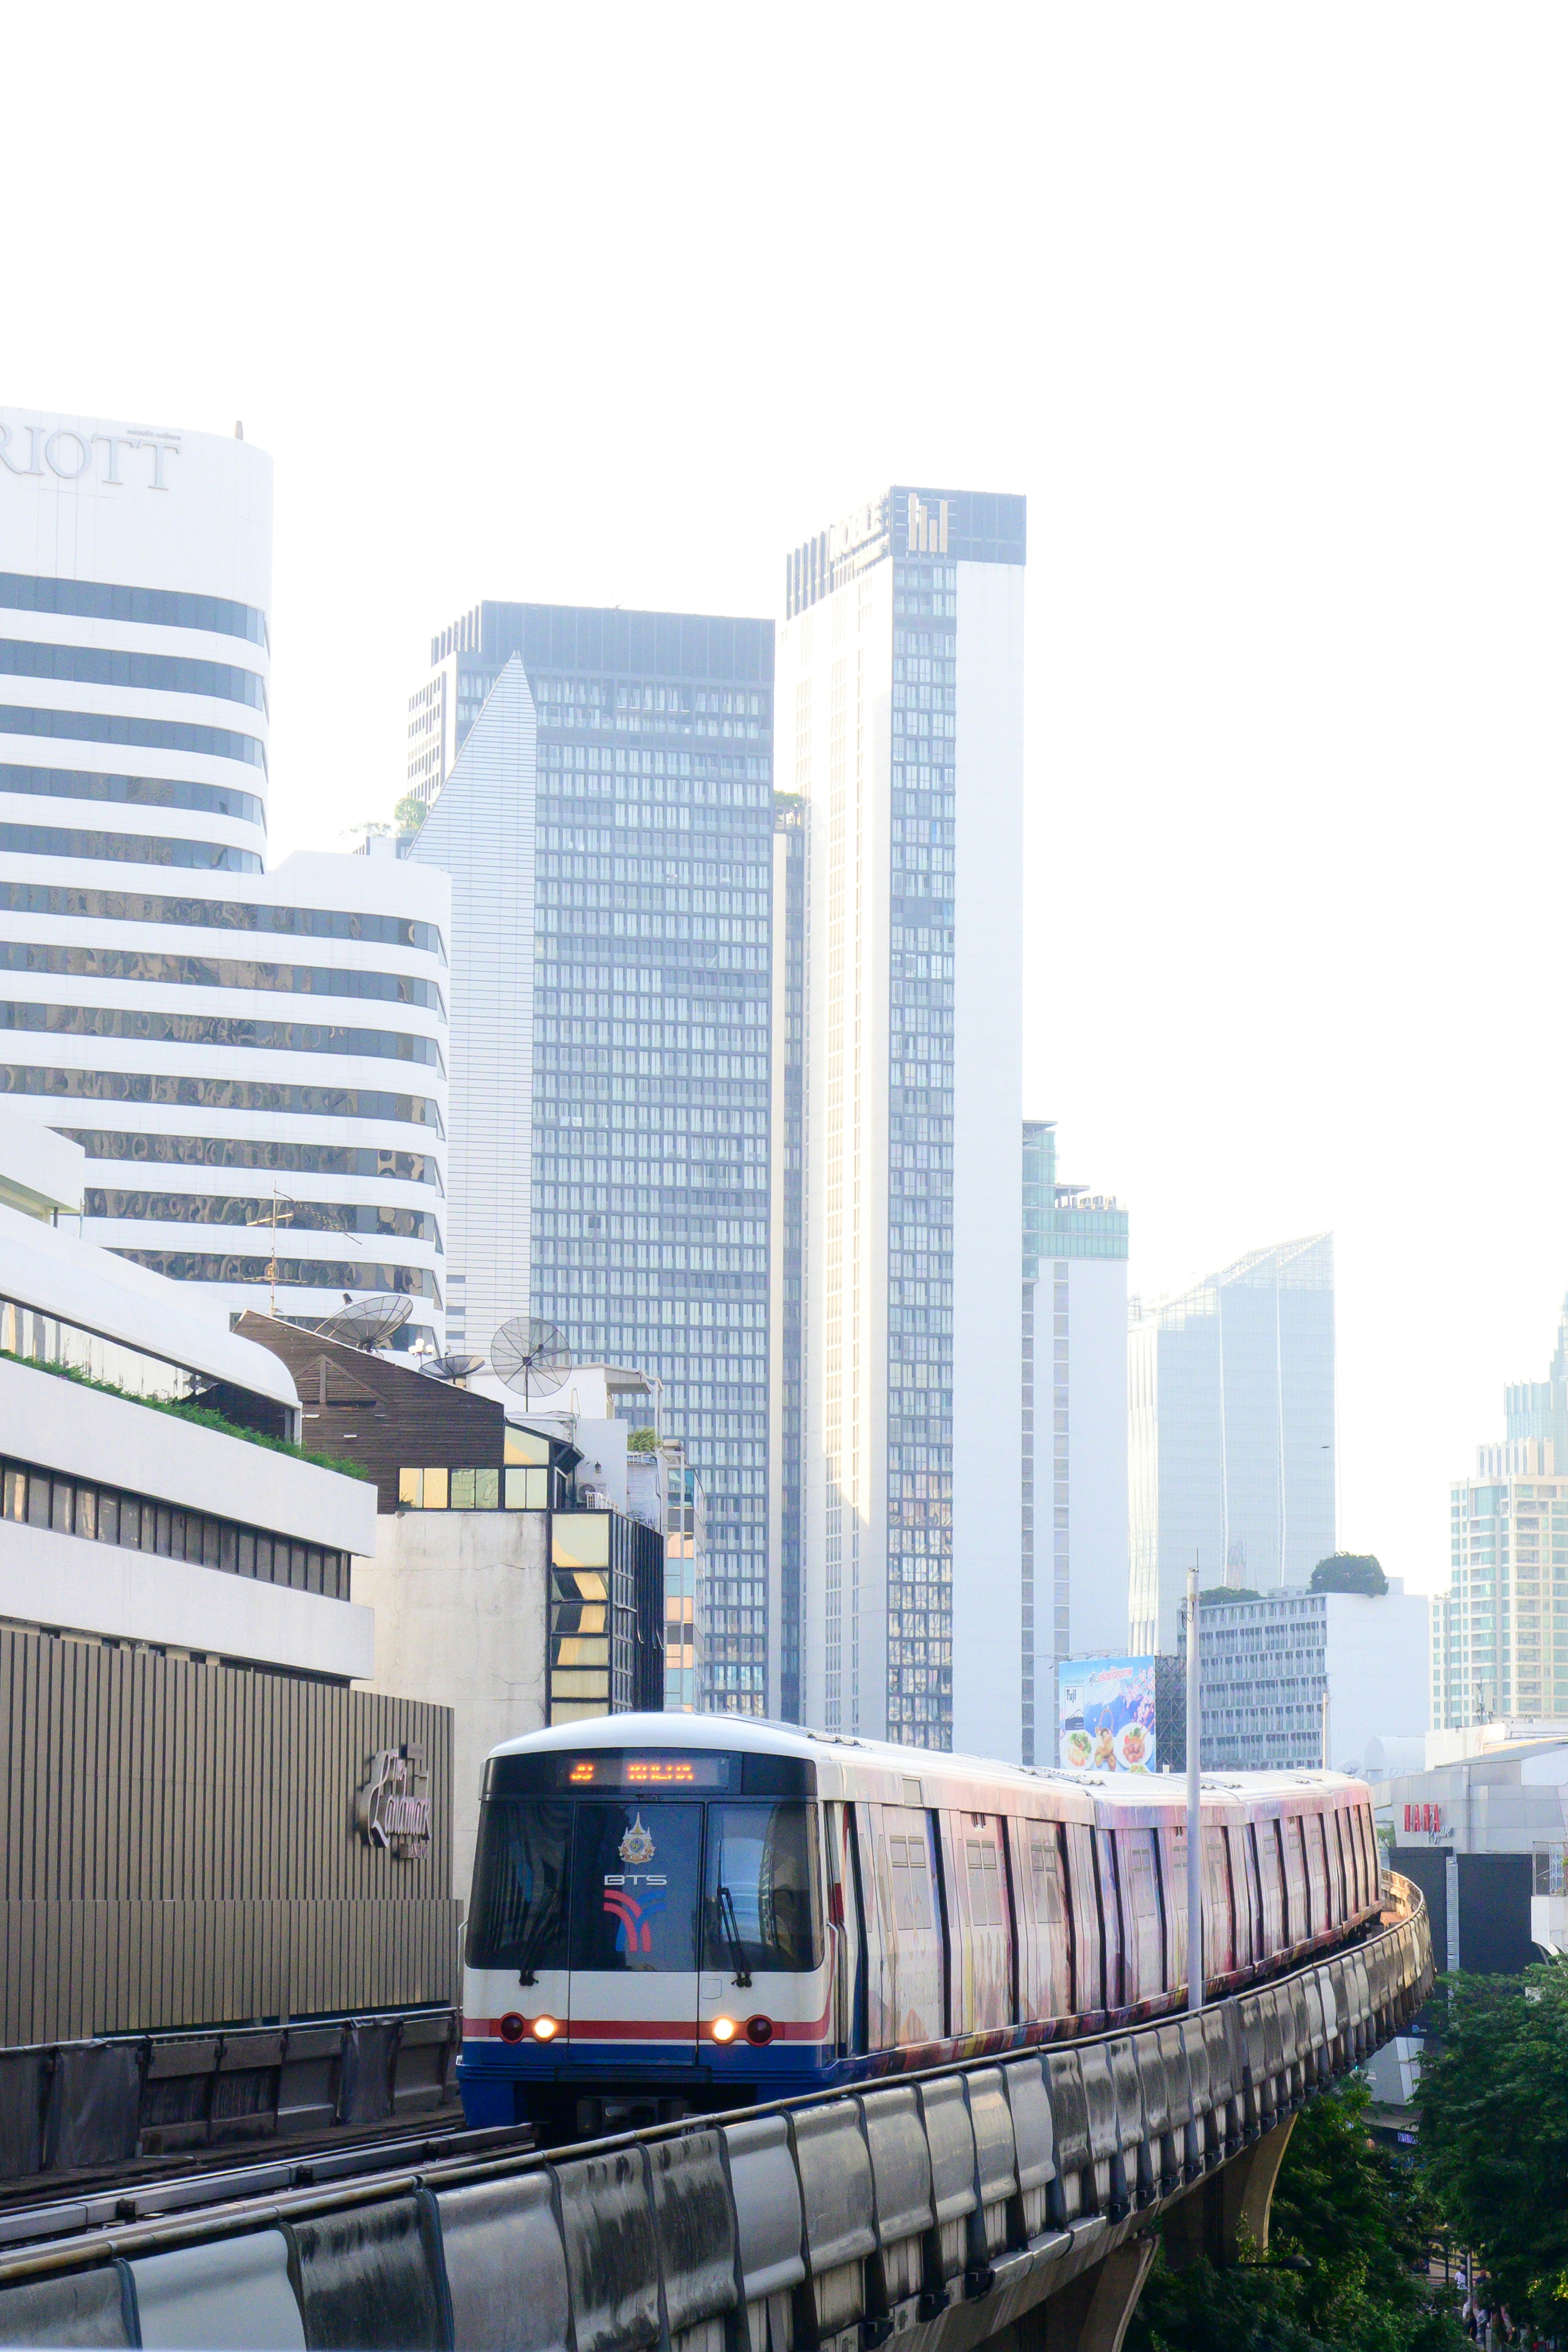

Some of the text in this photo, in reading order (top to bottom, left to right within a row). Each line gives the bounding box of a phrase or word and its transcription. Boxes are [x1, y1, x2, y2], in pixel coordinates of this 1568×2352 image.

[829, 497, 882, 562] NOBLE
[1066, 1689, 1077, 1703] Fuji
[604, 1875, 667, 1886] BTS
